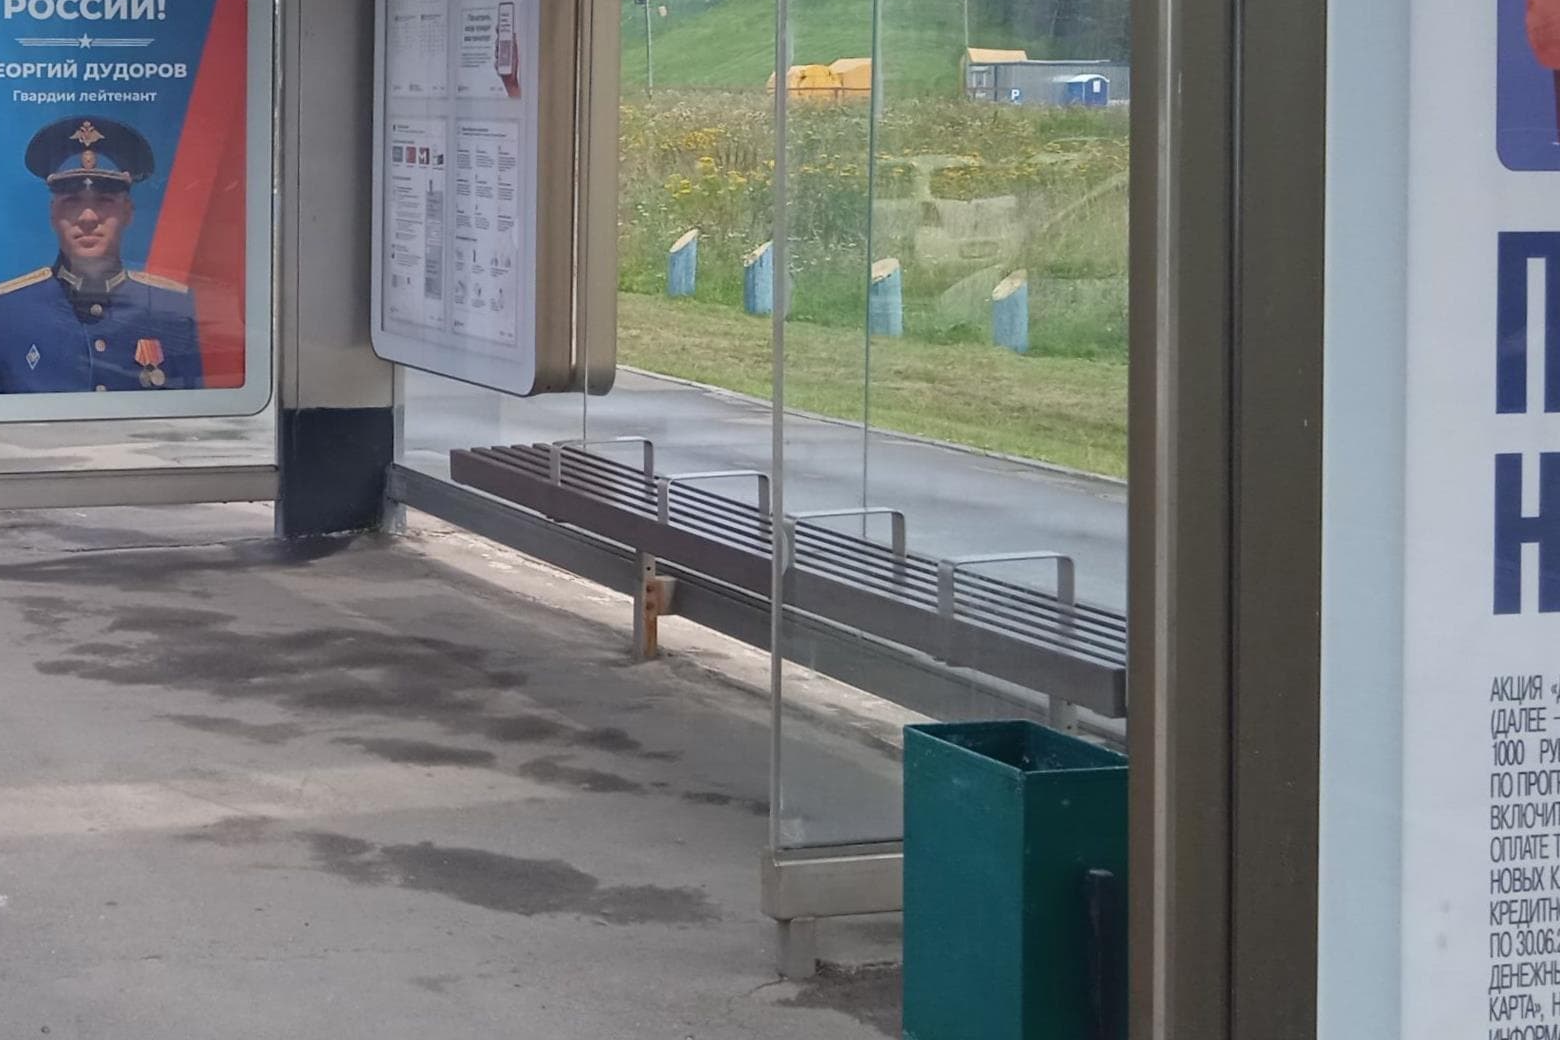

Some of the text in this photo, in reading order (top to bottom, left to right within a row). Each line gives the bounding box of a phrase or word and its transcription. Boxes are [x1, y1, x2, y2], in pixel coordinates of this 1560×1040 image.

[83, 62, 188, 81] ДУДОРОВ
[12, 89, 158, 104] Гвардии лейтенант
[1011, 89, 1020, 100] P
[1490, 674, 1543, 705] АКЦИЯ
[1490, 707, 1547, 740] (ДАЛЕЕ
[1492, 739, 1525, 766] 1000
[1490, 771, 1513, 798] ПО
[1490, 833, 1550, 862] ОПЛАТЕ
[1490, 865, 1545, 895] НОВЫХ
[1490, 897, 1560, 929] КРЕДИТН
[1490, 931, 1513, 958] ПО
